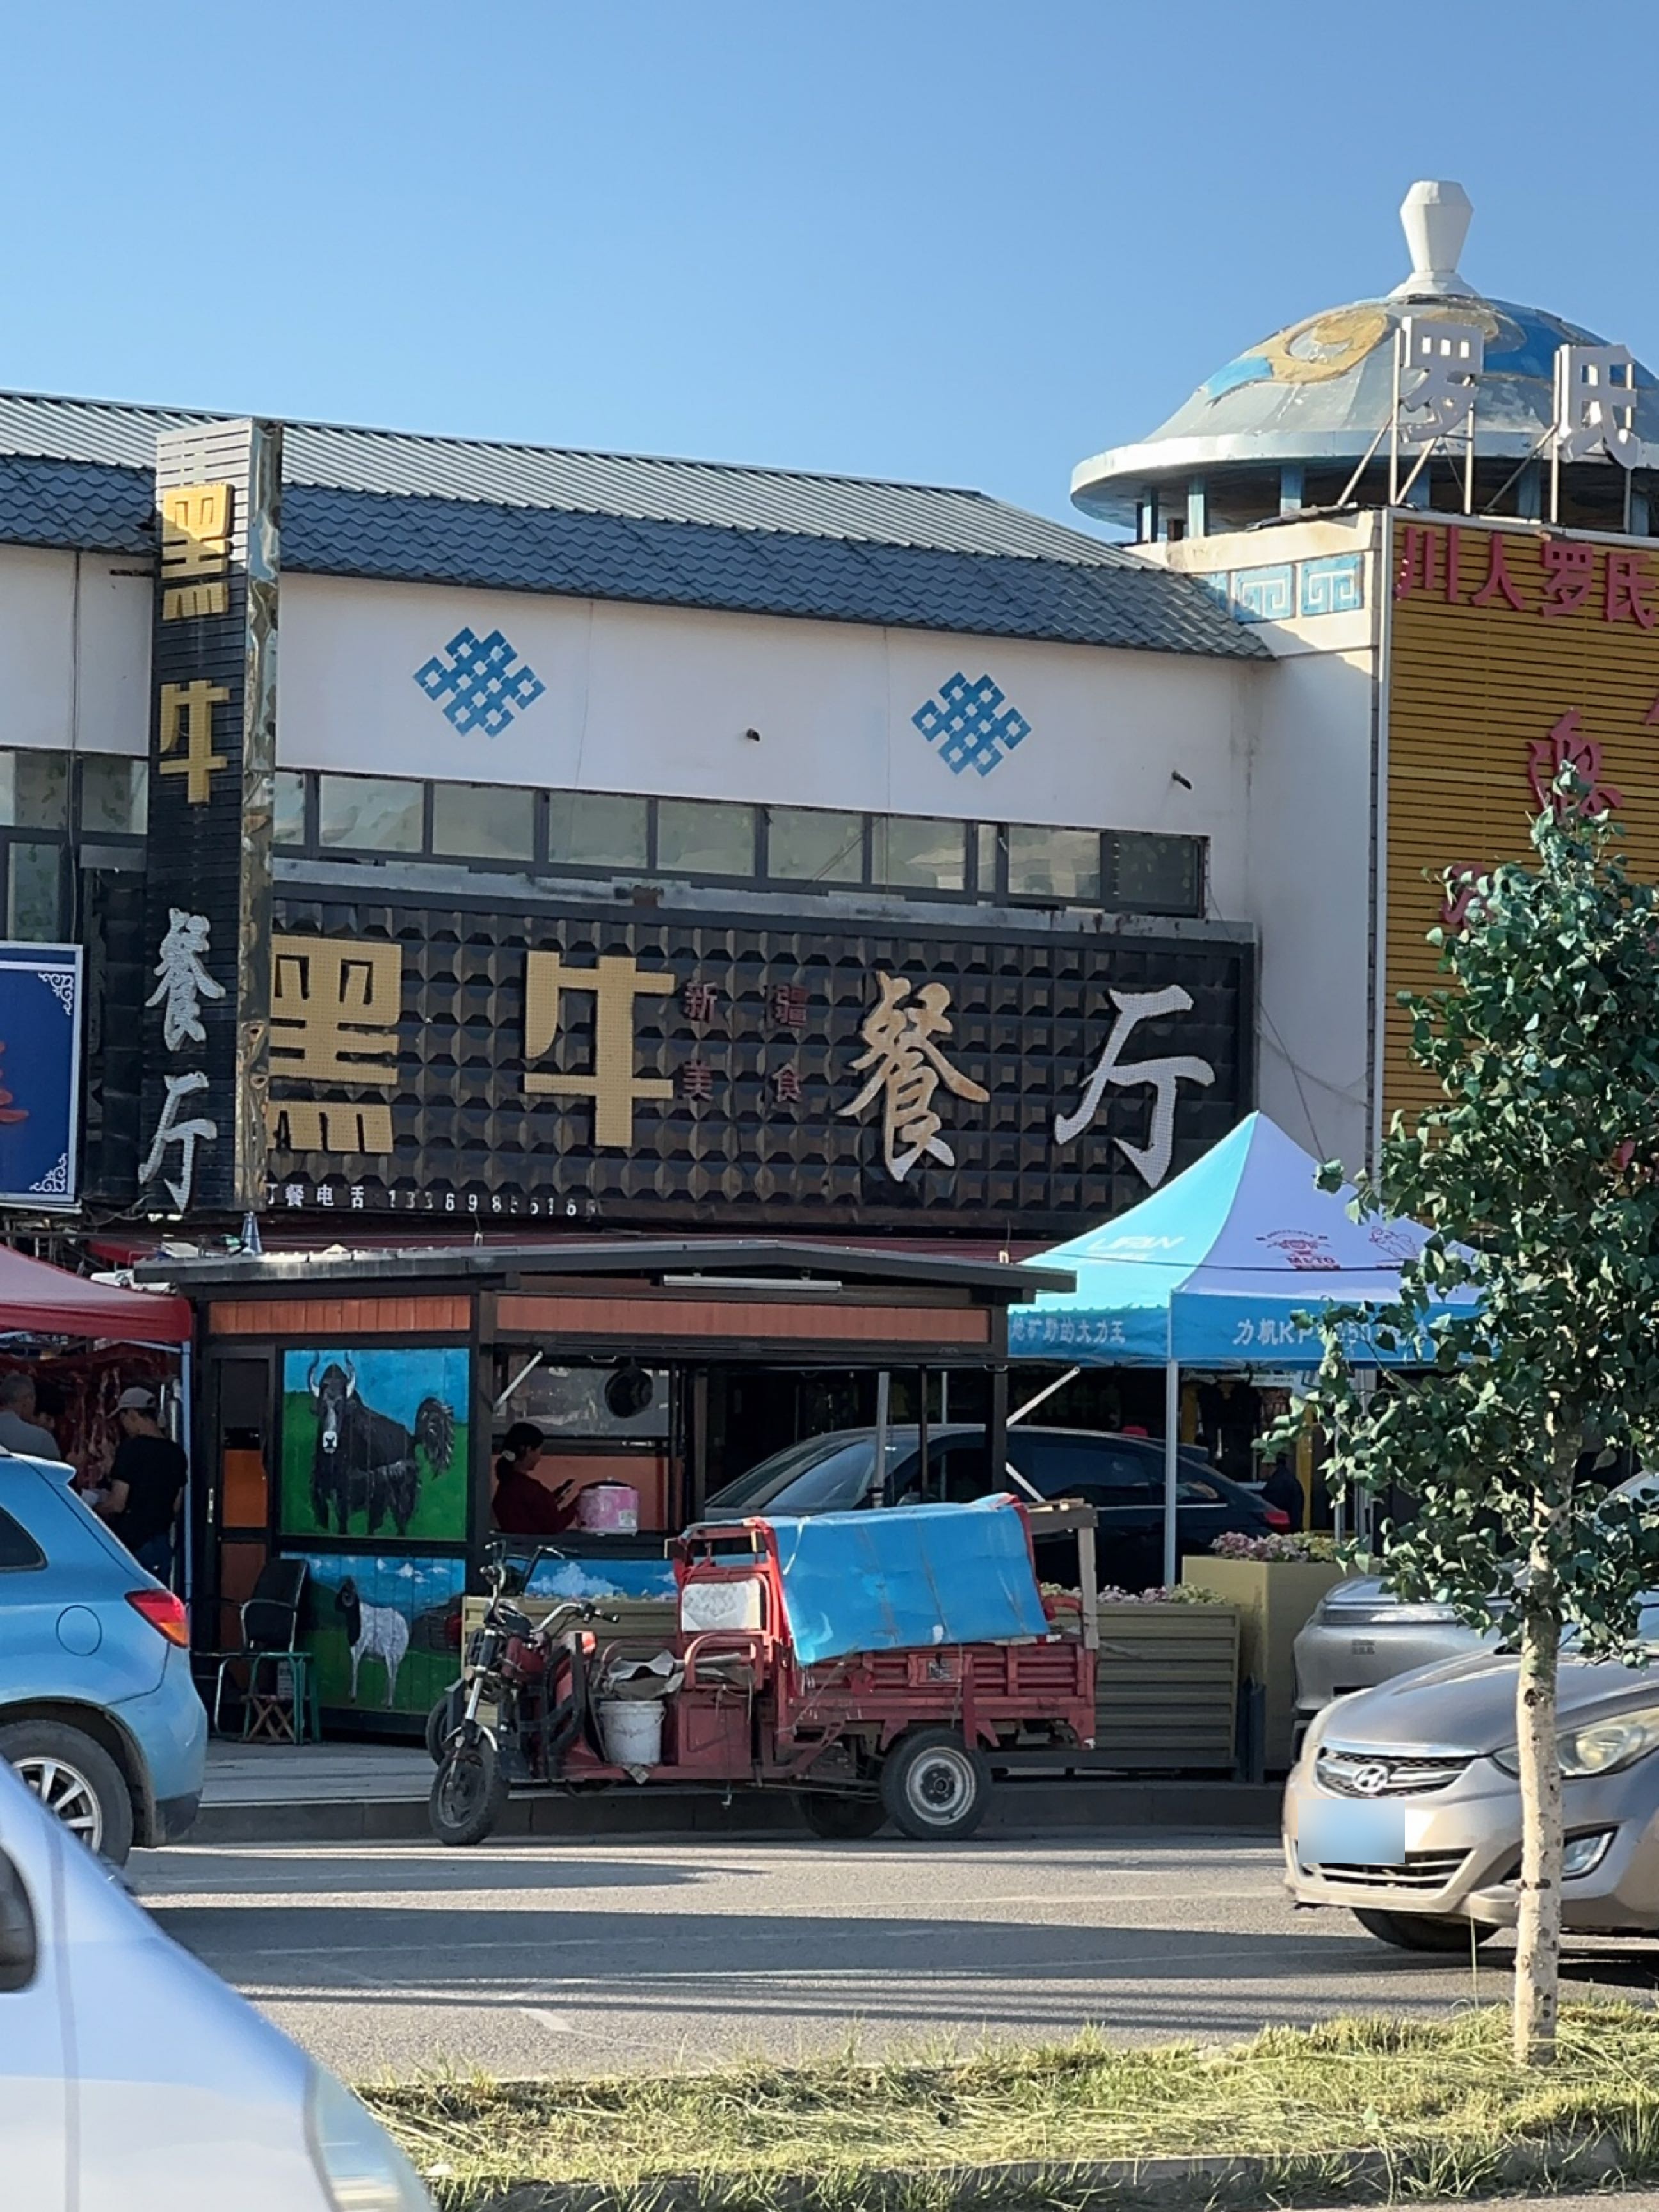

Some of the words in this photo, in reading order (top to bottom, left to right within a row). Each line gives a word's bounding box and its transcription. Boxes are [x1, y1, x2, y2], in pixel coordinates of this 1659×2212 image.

[1395, 316, 1642, 470] 罗氏
[1395, 525, 1656, 629] 川人罗氏
[138, 482, 234, 1212] 黑牛餐厅
[681, 1059, 803, 1103] 美食
